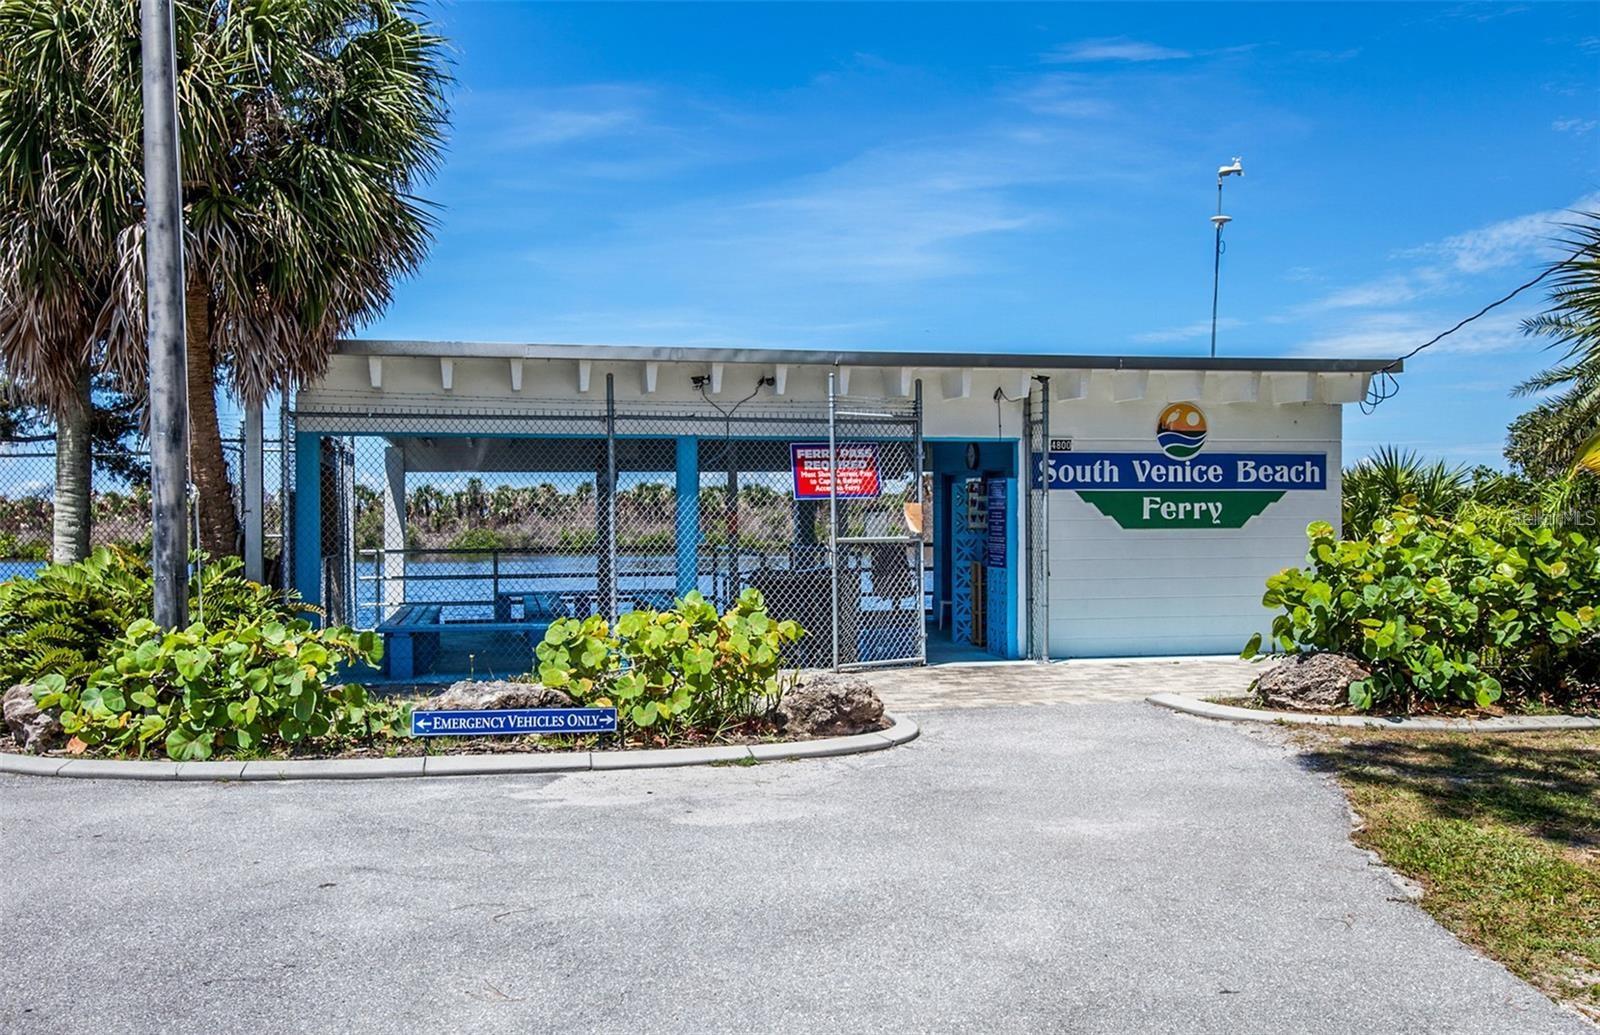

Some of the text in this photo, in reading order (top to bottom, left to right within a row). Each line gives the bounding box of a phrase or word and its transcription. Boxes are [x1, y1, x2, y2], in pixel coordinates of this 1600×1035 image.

[1051, 440, 1071, 450] 4800
[797, 449, 838, 459] FERR
[1038, 460, 1320, 483] South Venice Beach
[1143, 497, 1222, 524] Ferry
